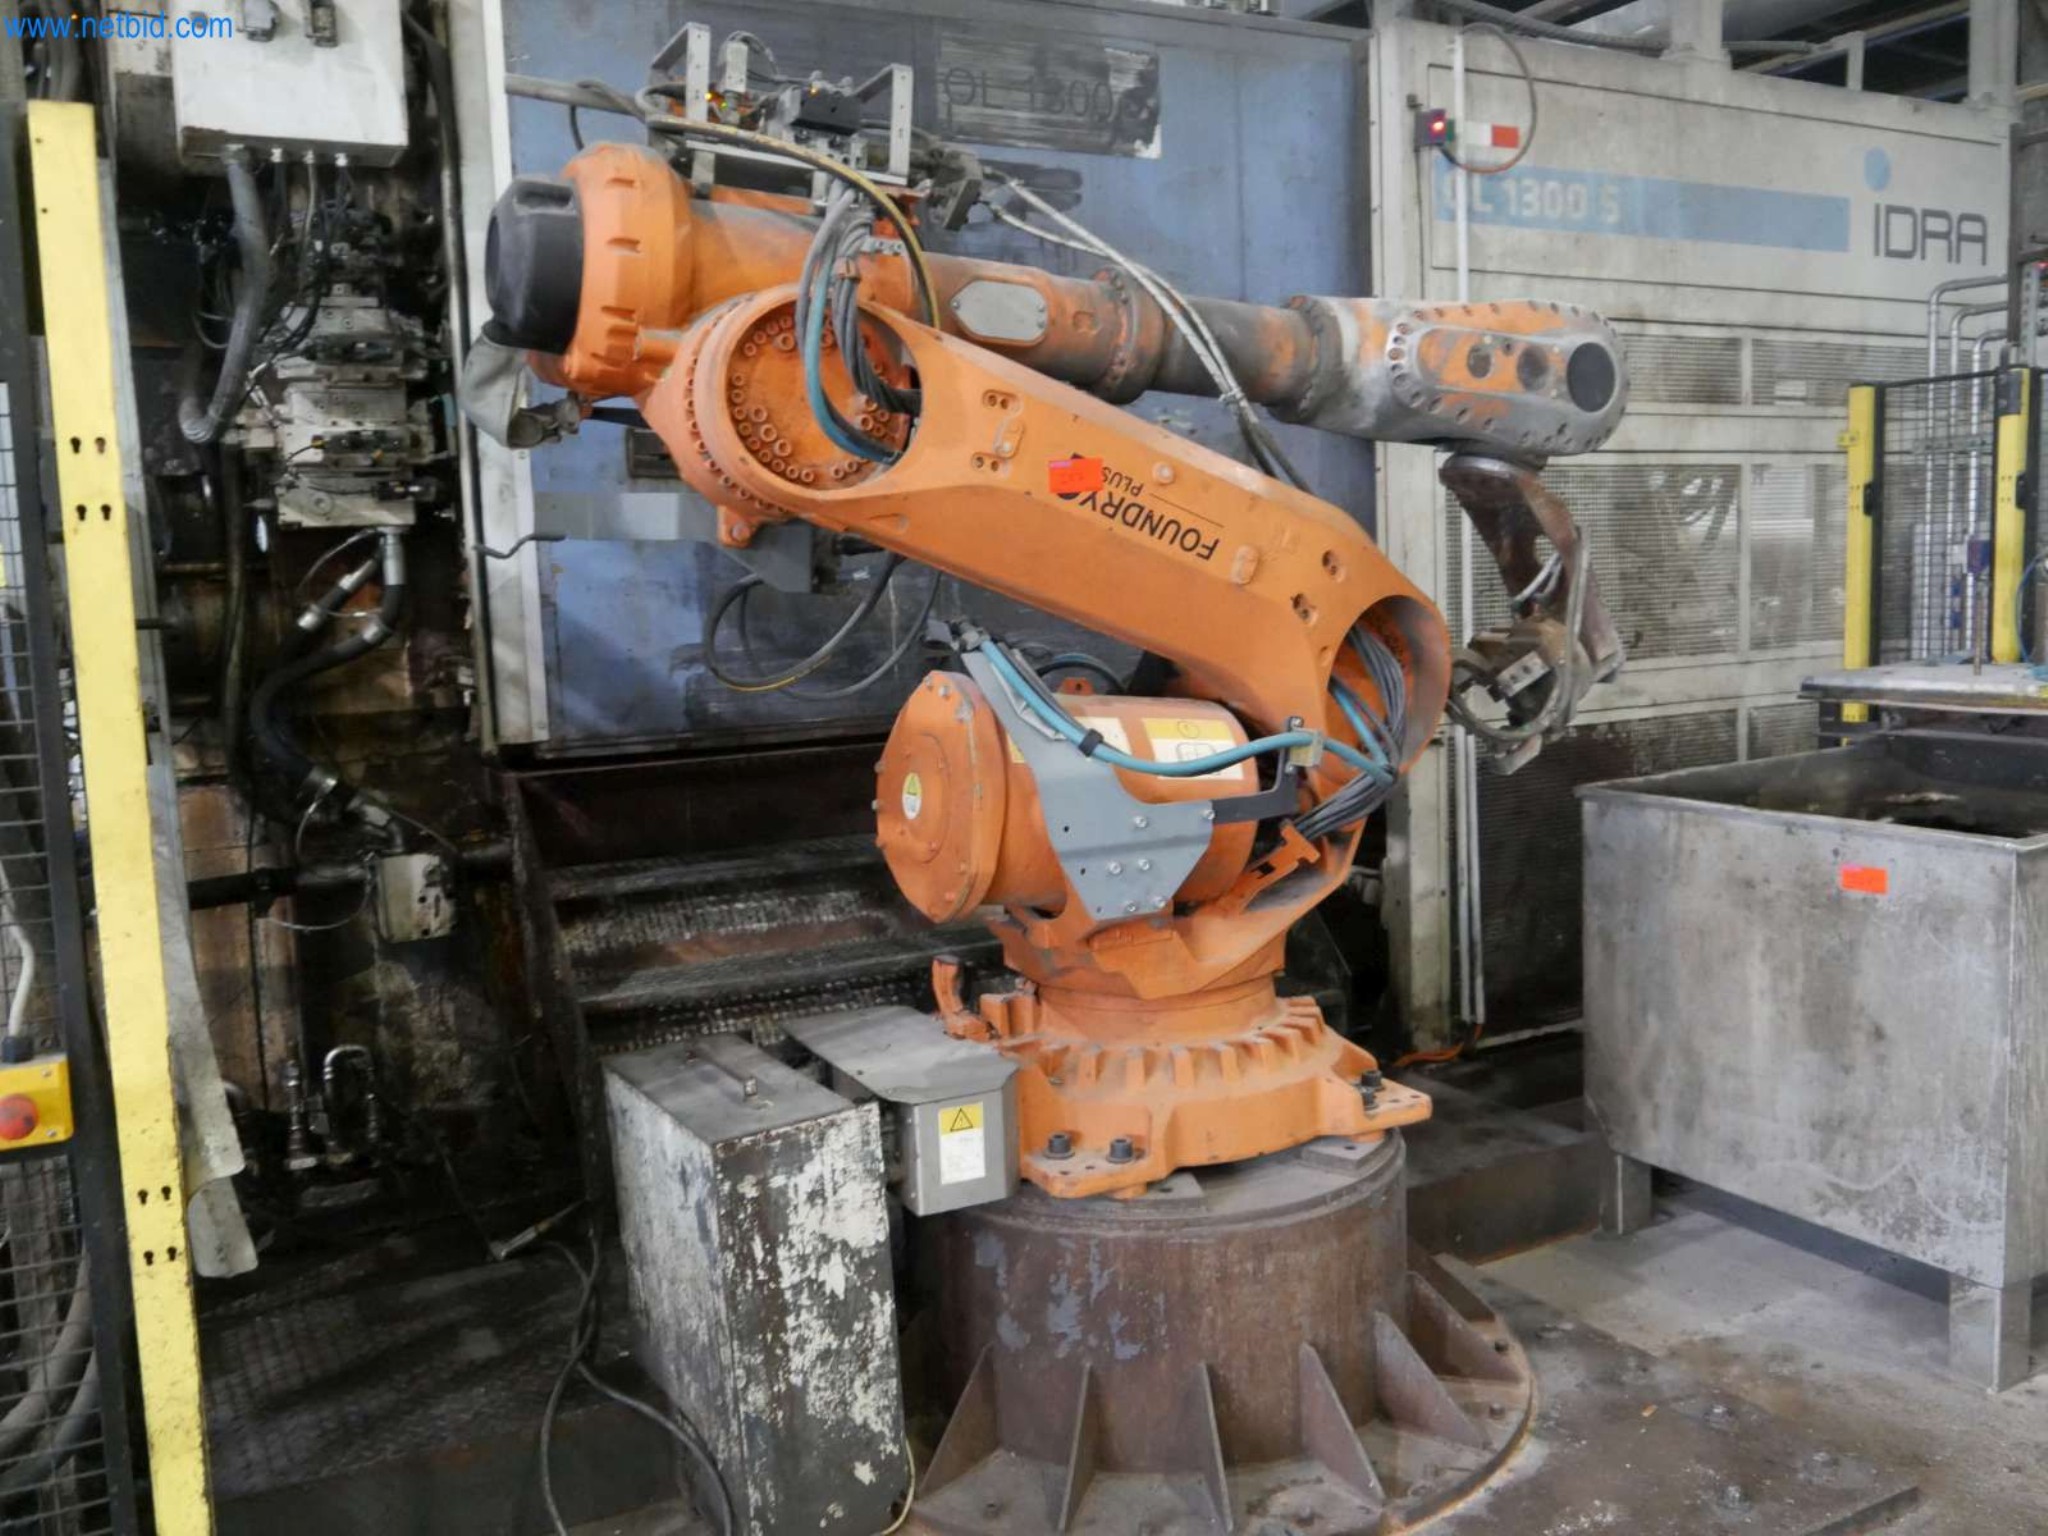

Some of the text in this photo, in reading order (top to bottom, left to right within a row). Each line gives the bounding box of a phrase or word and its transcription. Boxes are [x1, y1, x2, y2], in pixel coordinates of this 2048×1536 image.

[1502, 177, 1588, 219] 1300
[1874, 202, 1988, 266] IDRA
[1101, 466, 1144, 497] PLUS
[1079, 491, 1220, 561] FOUNDRY
